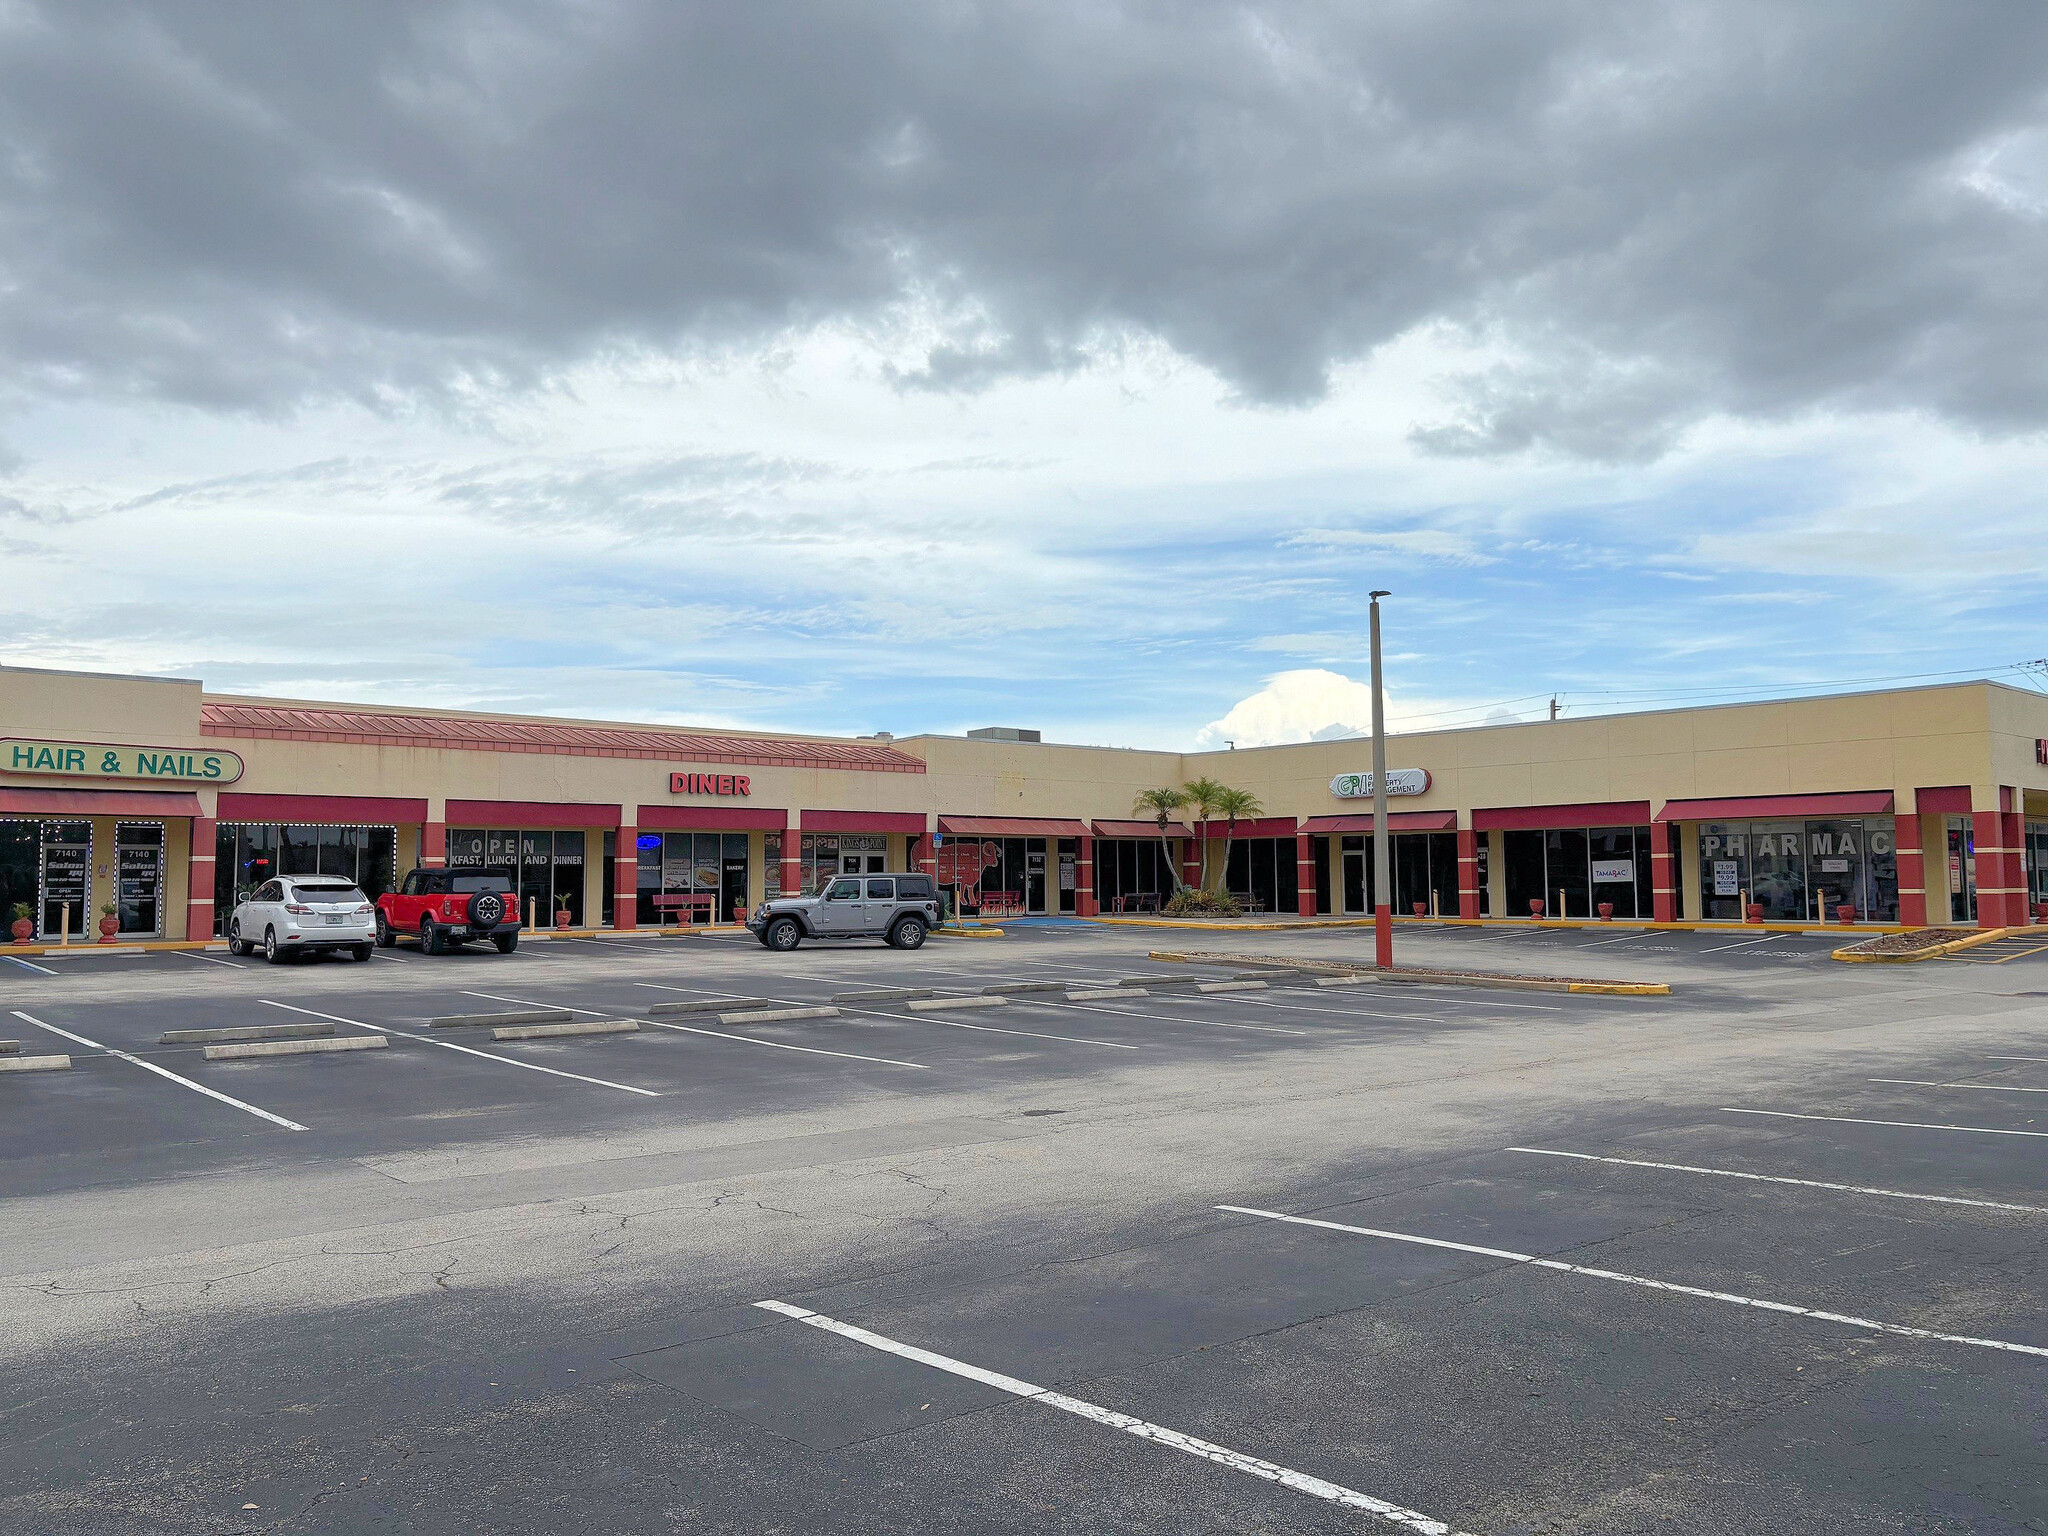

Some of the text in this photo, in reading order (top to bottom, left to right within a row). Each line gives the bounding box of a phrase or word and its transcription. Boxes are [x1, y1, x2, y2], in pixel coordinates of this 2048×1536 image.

[12, 746, 222, 778] HAIR & NAILS
[670, 772, 751, 796] DINER
[1368, 779, 1402, 788] PERTY
[1368, 785, 1416, 795] MGEMENT
[471, 839, 534, 854] OPEN
[869, 837, 886, 849] POINT
[1705, 832, 1890, 857] PHARMAC
[449, 855, 582, 866] KFAST, LUNCH AND DINNER
